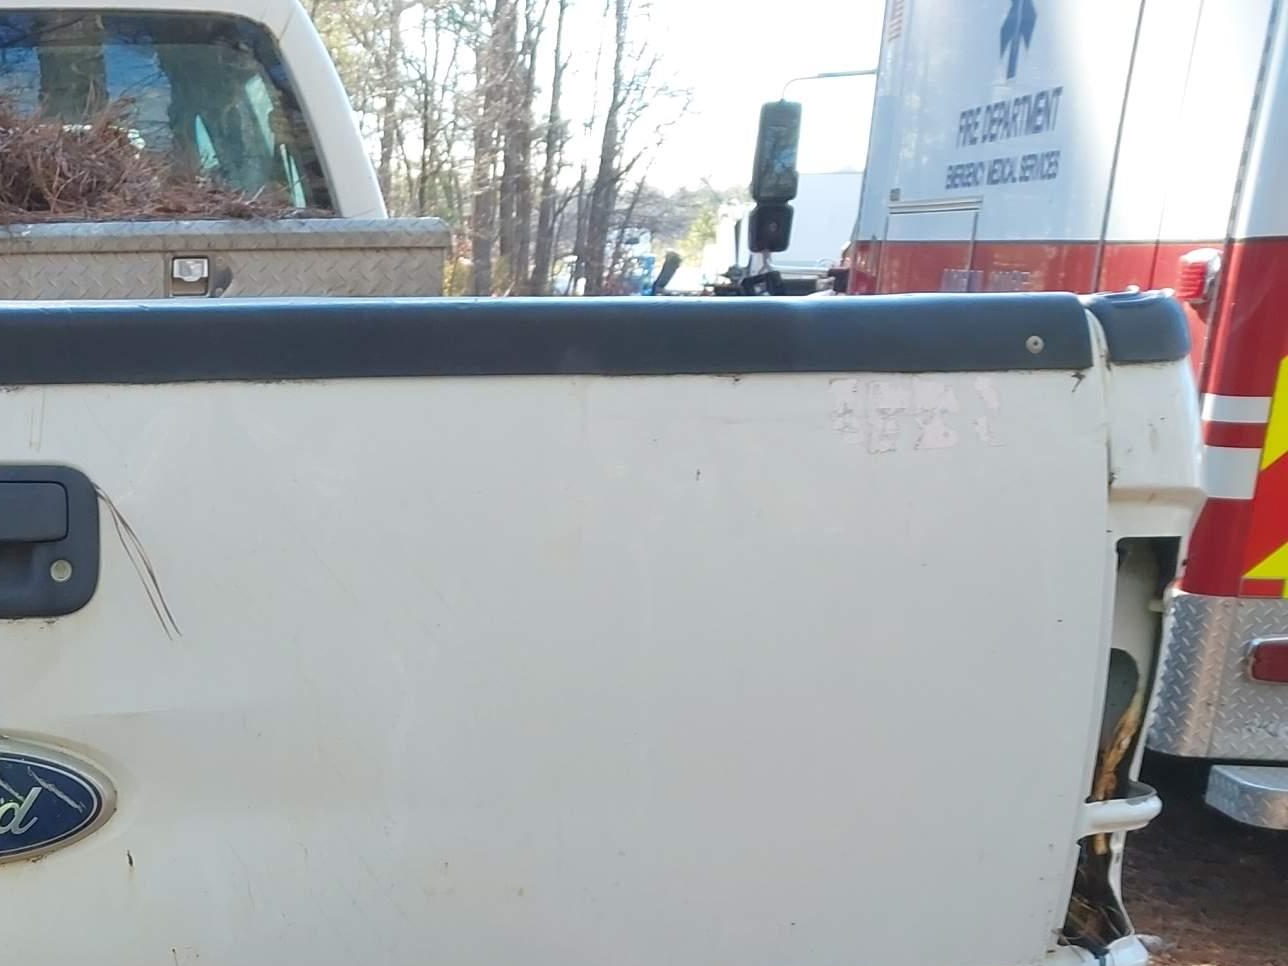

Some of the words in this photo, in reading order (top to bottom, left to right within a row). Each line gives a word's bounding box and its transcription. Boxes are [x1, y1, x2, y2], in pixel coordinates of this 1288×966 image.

[956, 107, 981, 148] FIRE
[980, 86, 1064, 143] DEPARTMENT
[1019, 150, 1061, 183] SERVICES
